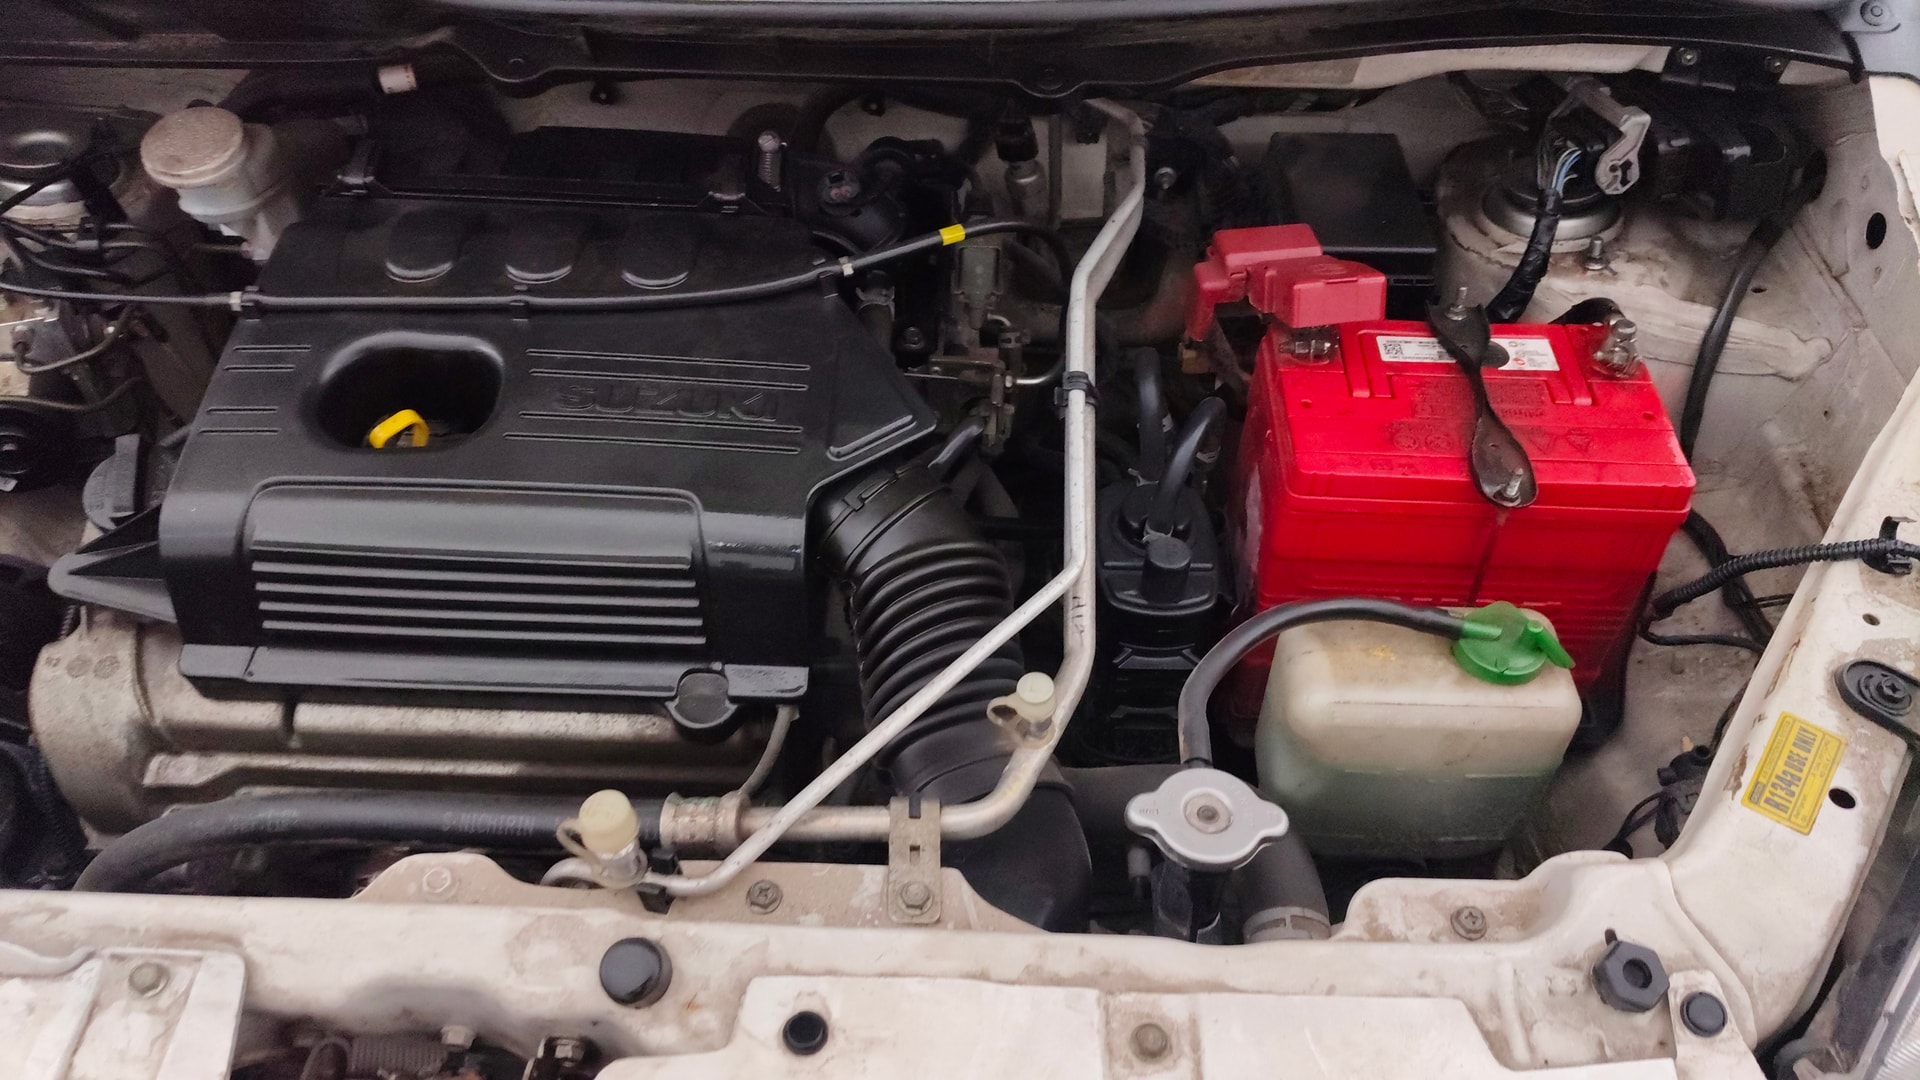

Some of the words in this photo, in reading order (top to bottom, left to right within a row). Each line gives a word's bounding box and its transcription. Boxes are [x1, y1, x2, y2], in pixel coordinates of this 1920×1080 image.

[557, 384, 777, 422] SUZUKI
[1792, 726, 1818, 754] ONLY
[1784, 751, 1808, 773] USE
